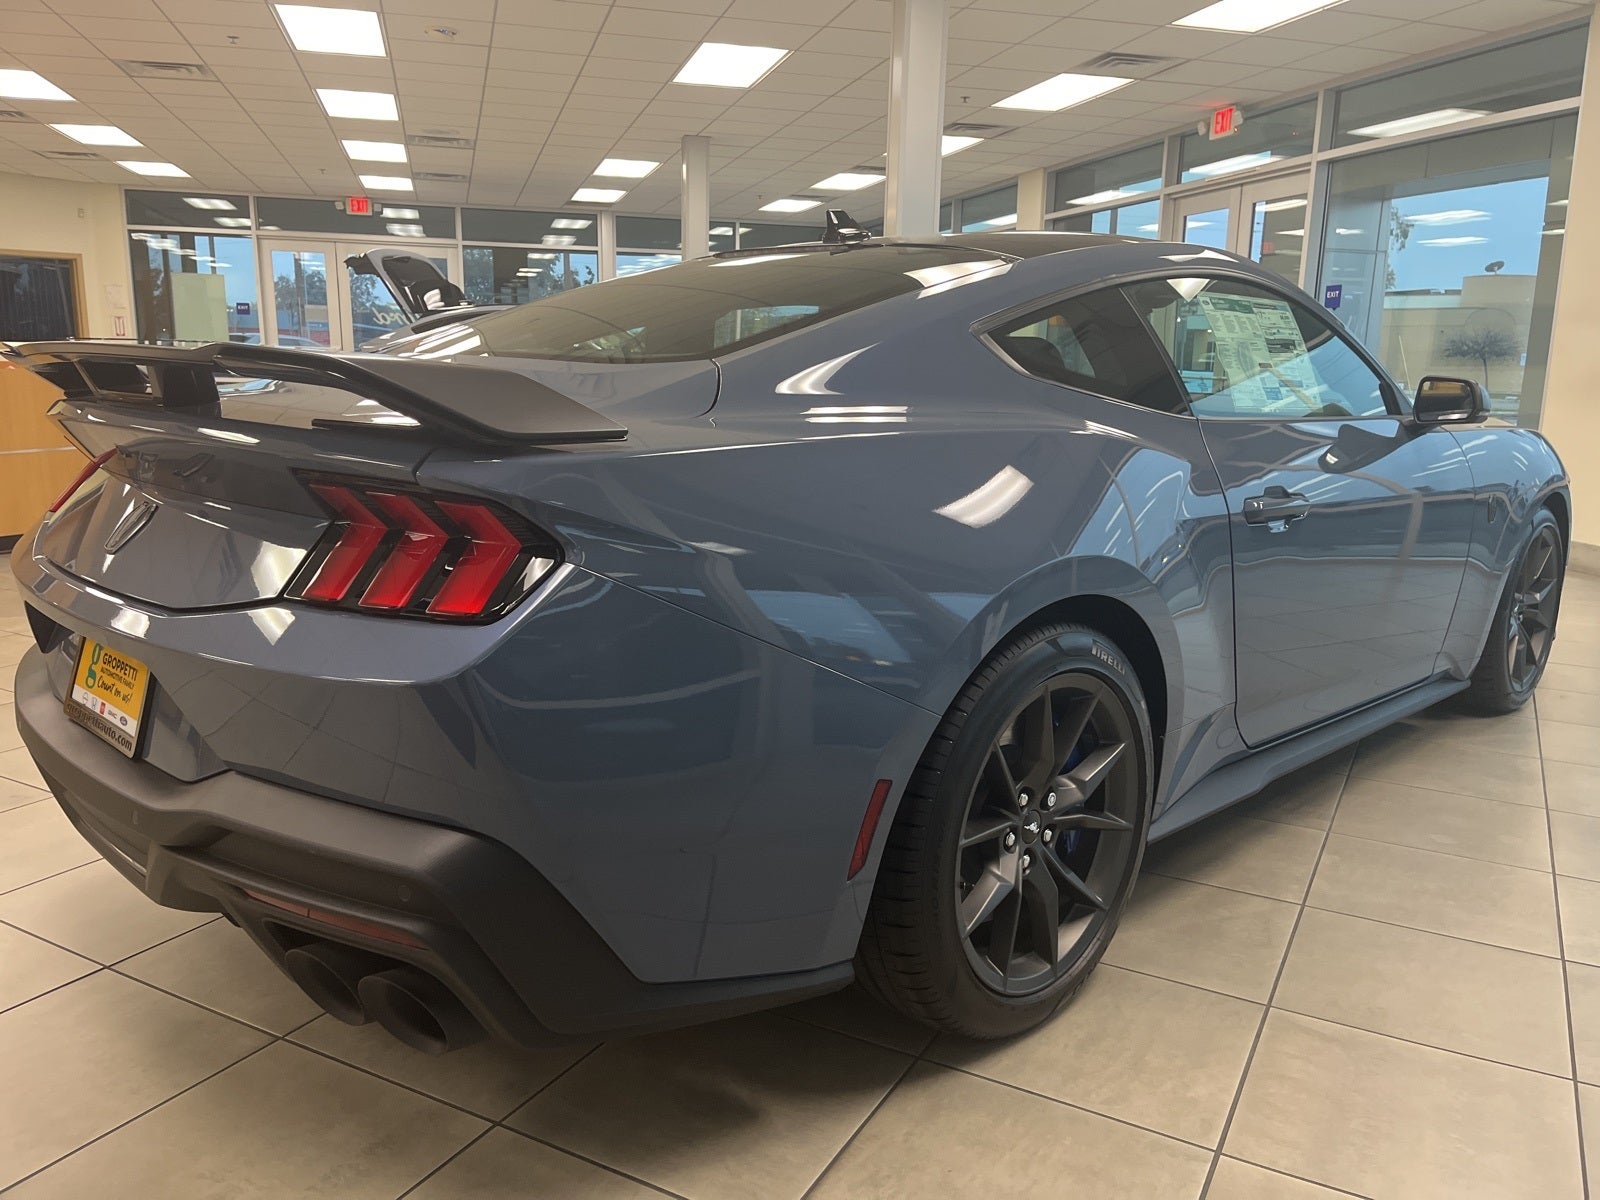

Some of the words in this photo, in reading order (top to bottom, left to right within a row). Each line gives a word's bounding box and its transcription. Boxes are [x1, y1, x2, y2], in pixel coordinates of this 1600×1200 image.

[1214, 108, 1234, 134] EXIT
[350, 198, 368, 213] EXIT
[1326, 290, 1339, 299] EXIT
[102, 652, 138, 682] GROPPETTI
[97, 675, 115, 694] Count
[113, 687, 122, 698] on
